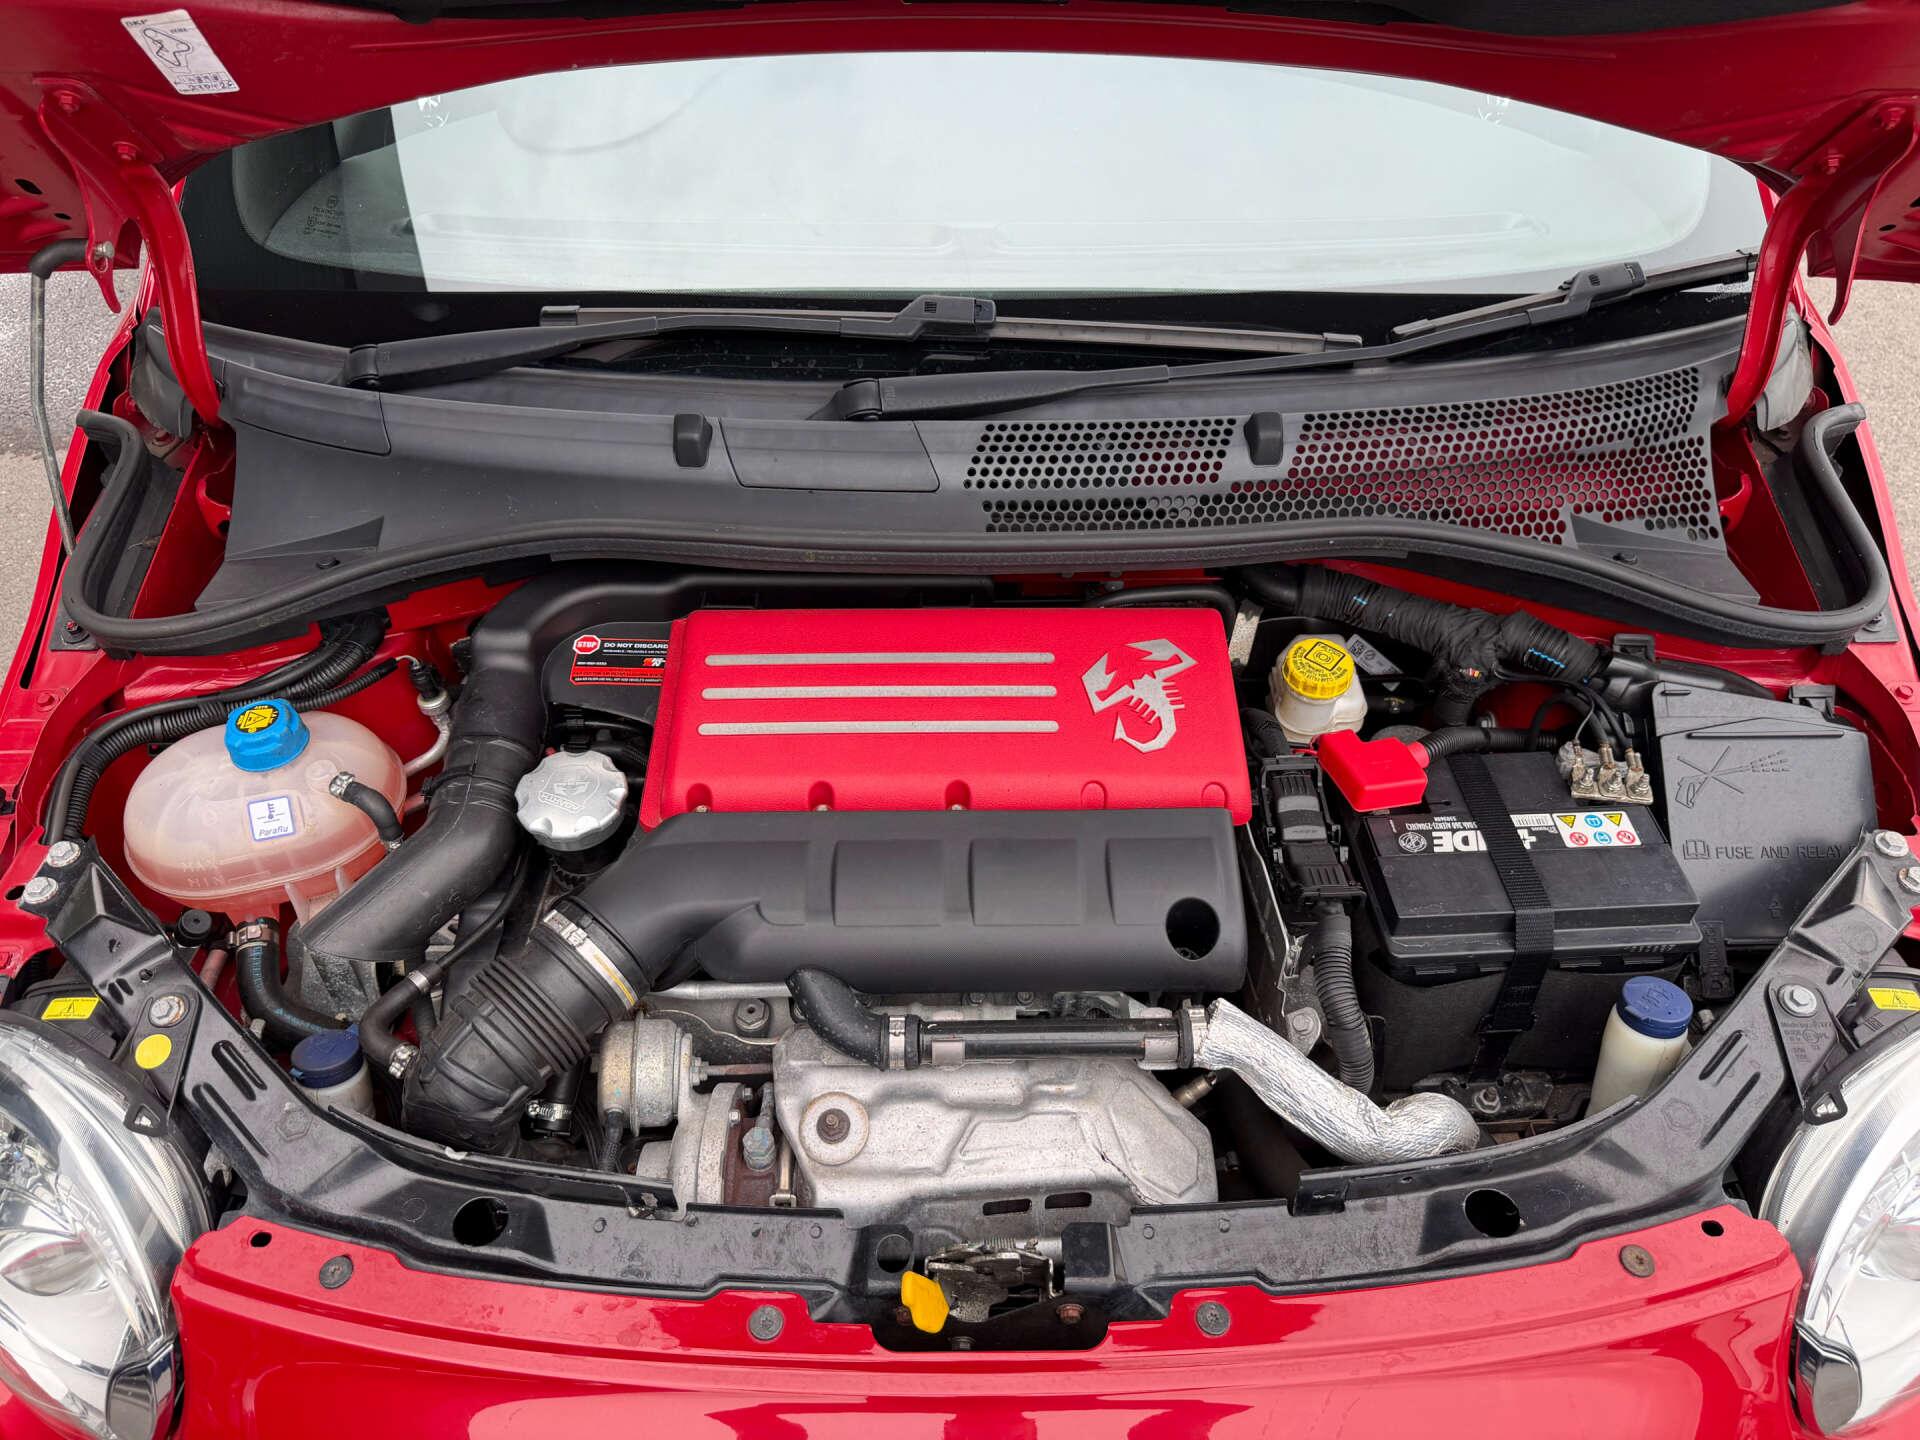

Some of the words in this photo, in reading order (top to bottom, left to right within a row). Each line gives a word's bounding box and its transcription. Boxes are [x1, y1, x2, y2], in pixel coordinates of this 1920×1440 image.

[577, 640, 597, 648] STOP
[1715, 846, 1753, 860] FUSE
[1760, 845, 1791, 859] AND
[1796, 845, 1843, 859] RELAY
